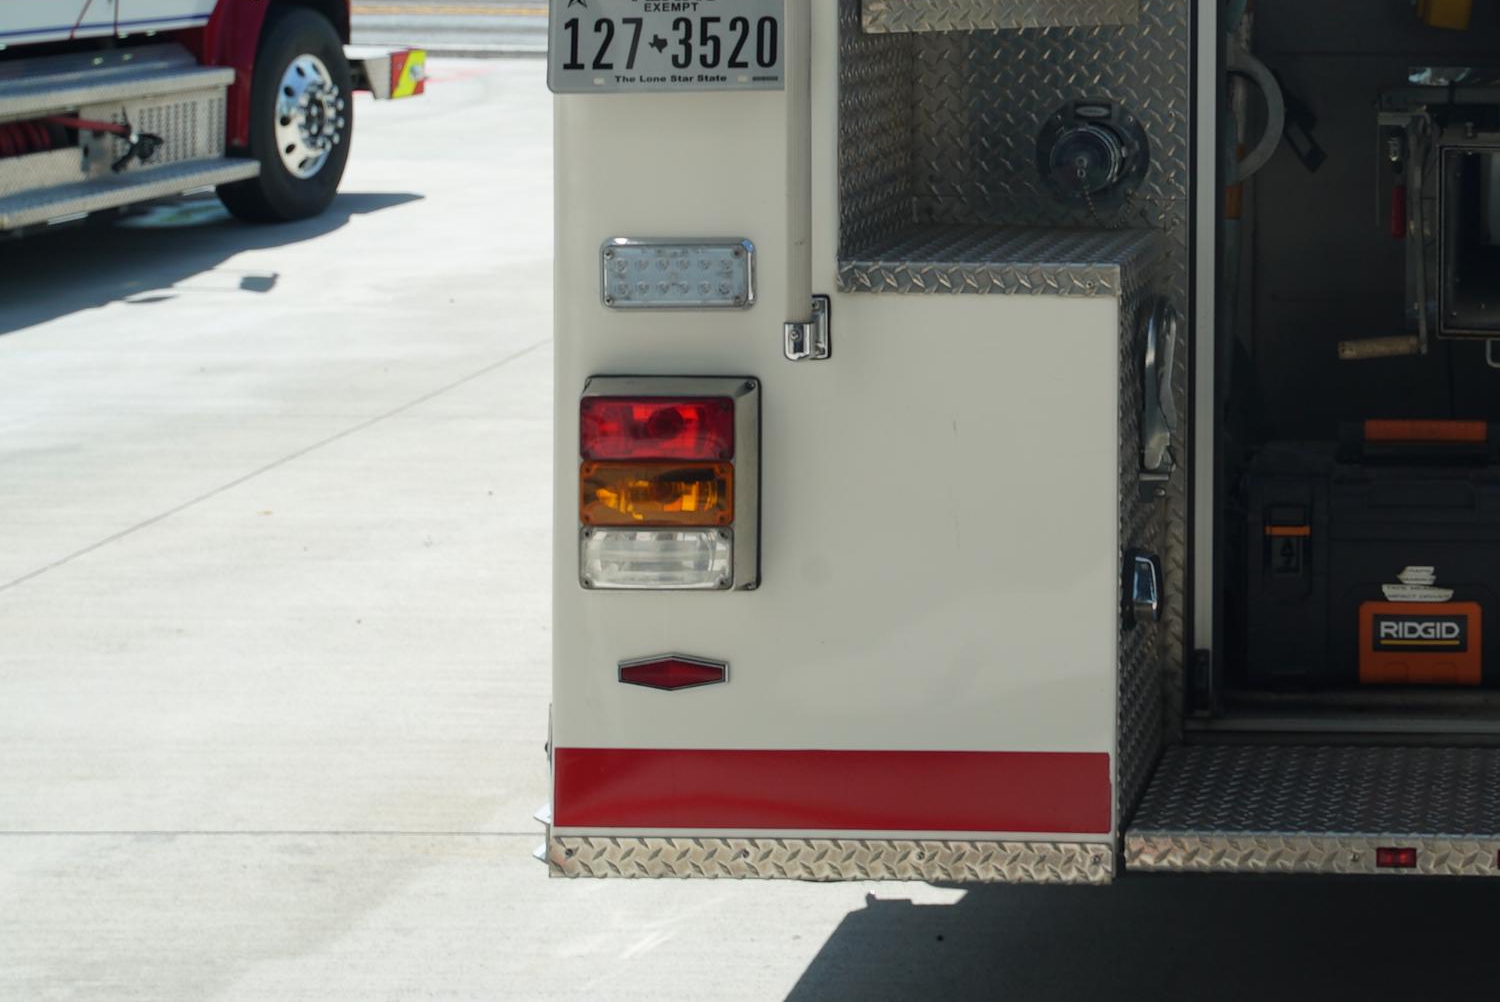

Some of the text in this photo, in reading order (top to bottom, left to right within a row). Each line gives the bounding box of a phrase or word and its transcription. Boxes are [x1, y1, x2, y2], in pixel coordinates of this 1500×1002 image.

[643, 1, 699, 13] EXEMPT
[562, 15, 778, 71] 127 3520
[614, 73, 727, 84] The Lone Star State
[1380, 621, 1460, 639] RIDGID
